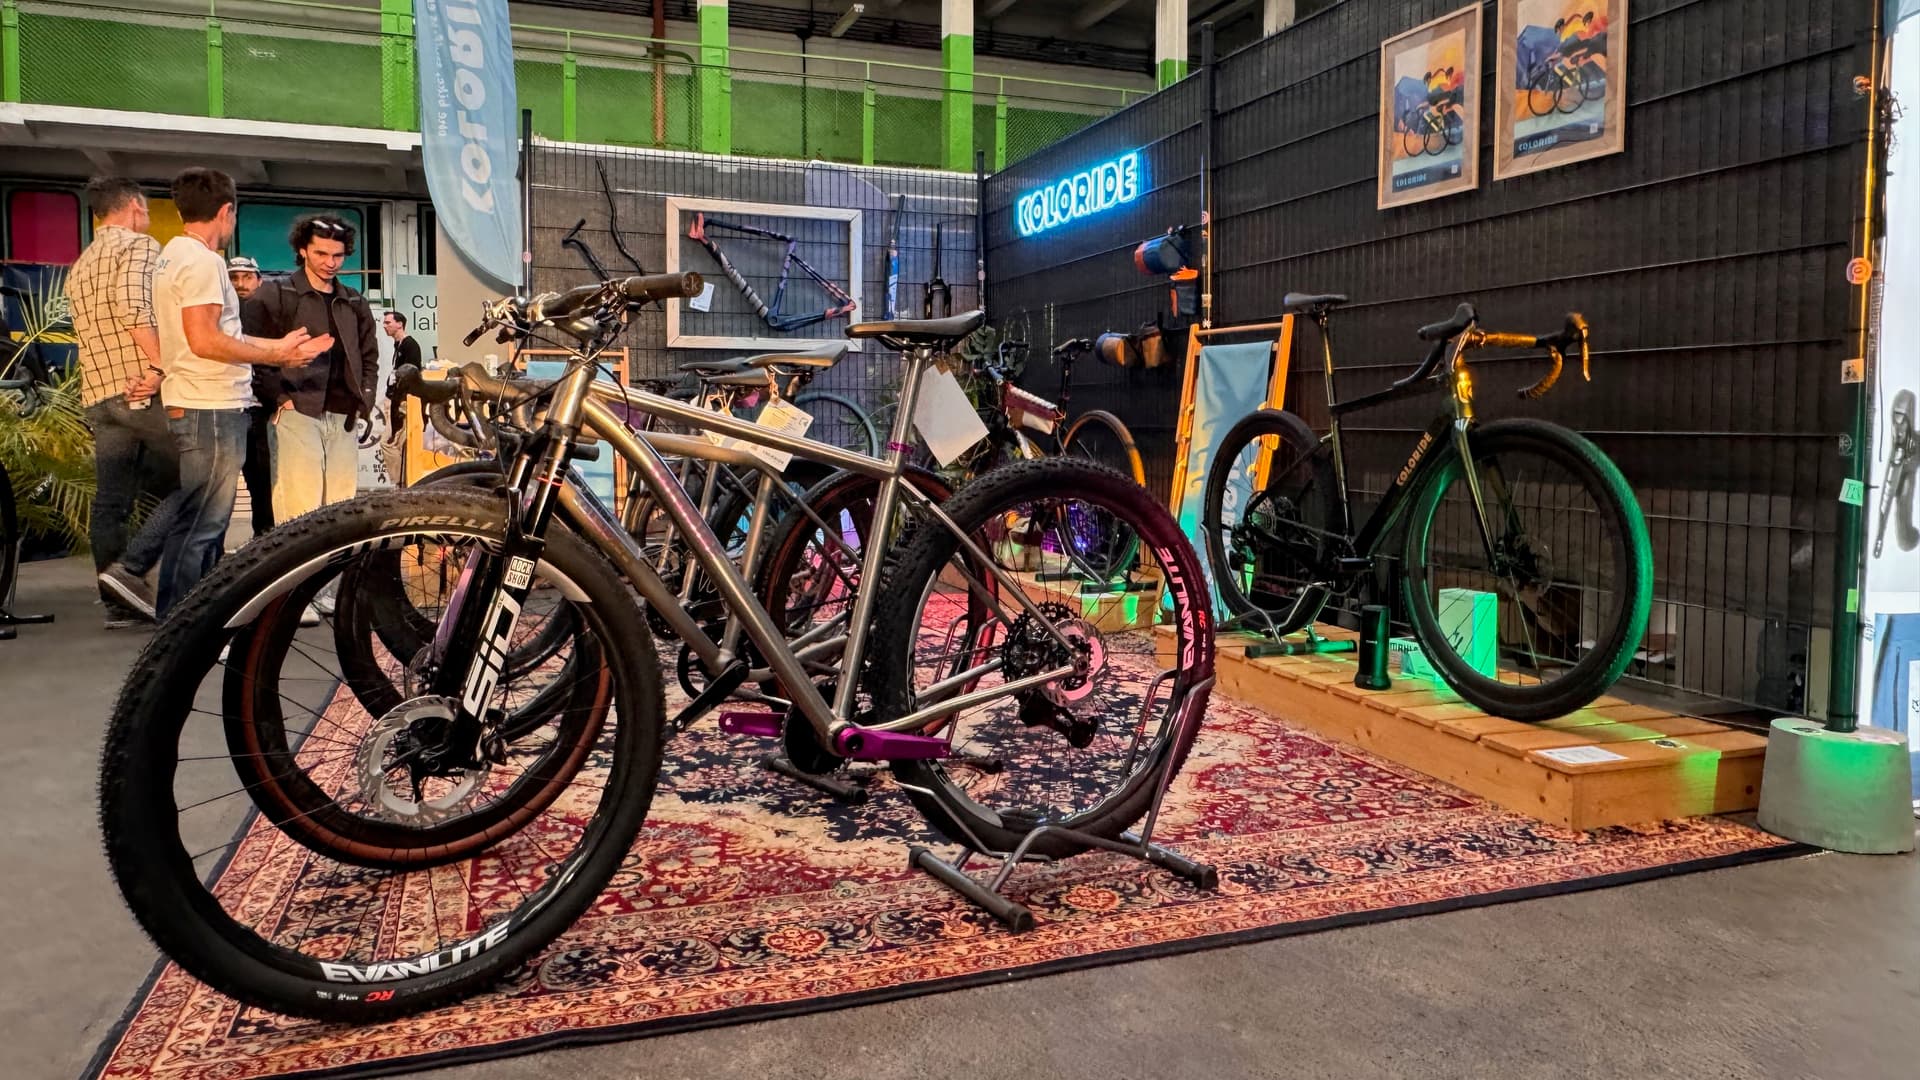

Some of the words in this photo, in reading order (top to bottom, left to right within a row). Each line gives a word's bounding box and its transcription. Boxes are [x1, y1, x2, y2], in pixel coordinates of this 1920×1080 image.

[380, 515, 495, 530] PIRELLI
[1157, 546, 1196, 671] EVANLITE
[320, 919, 511, 982] EVANLITE
[365, 989, 396, 1004] RC
